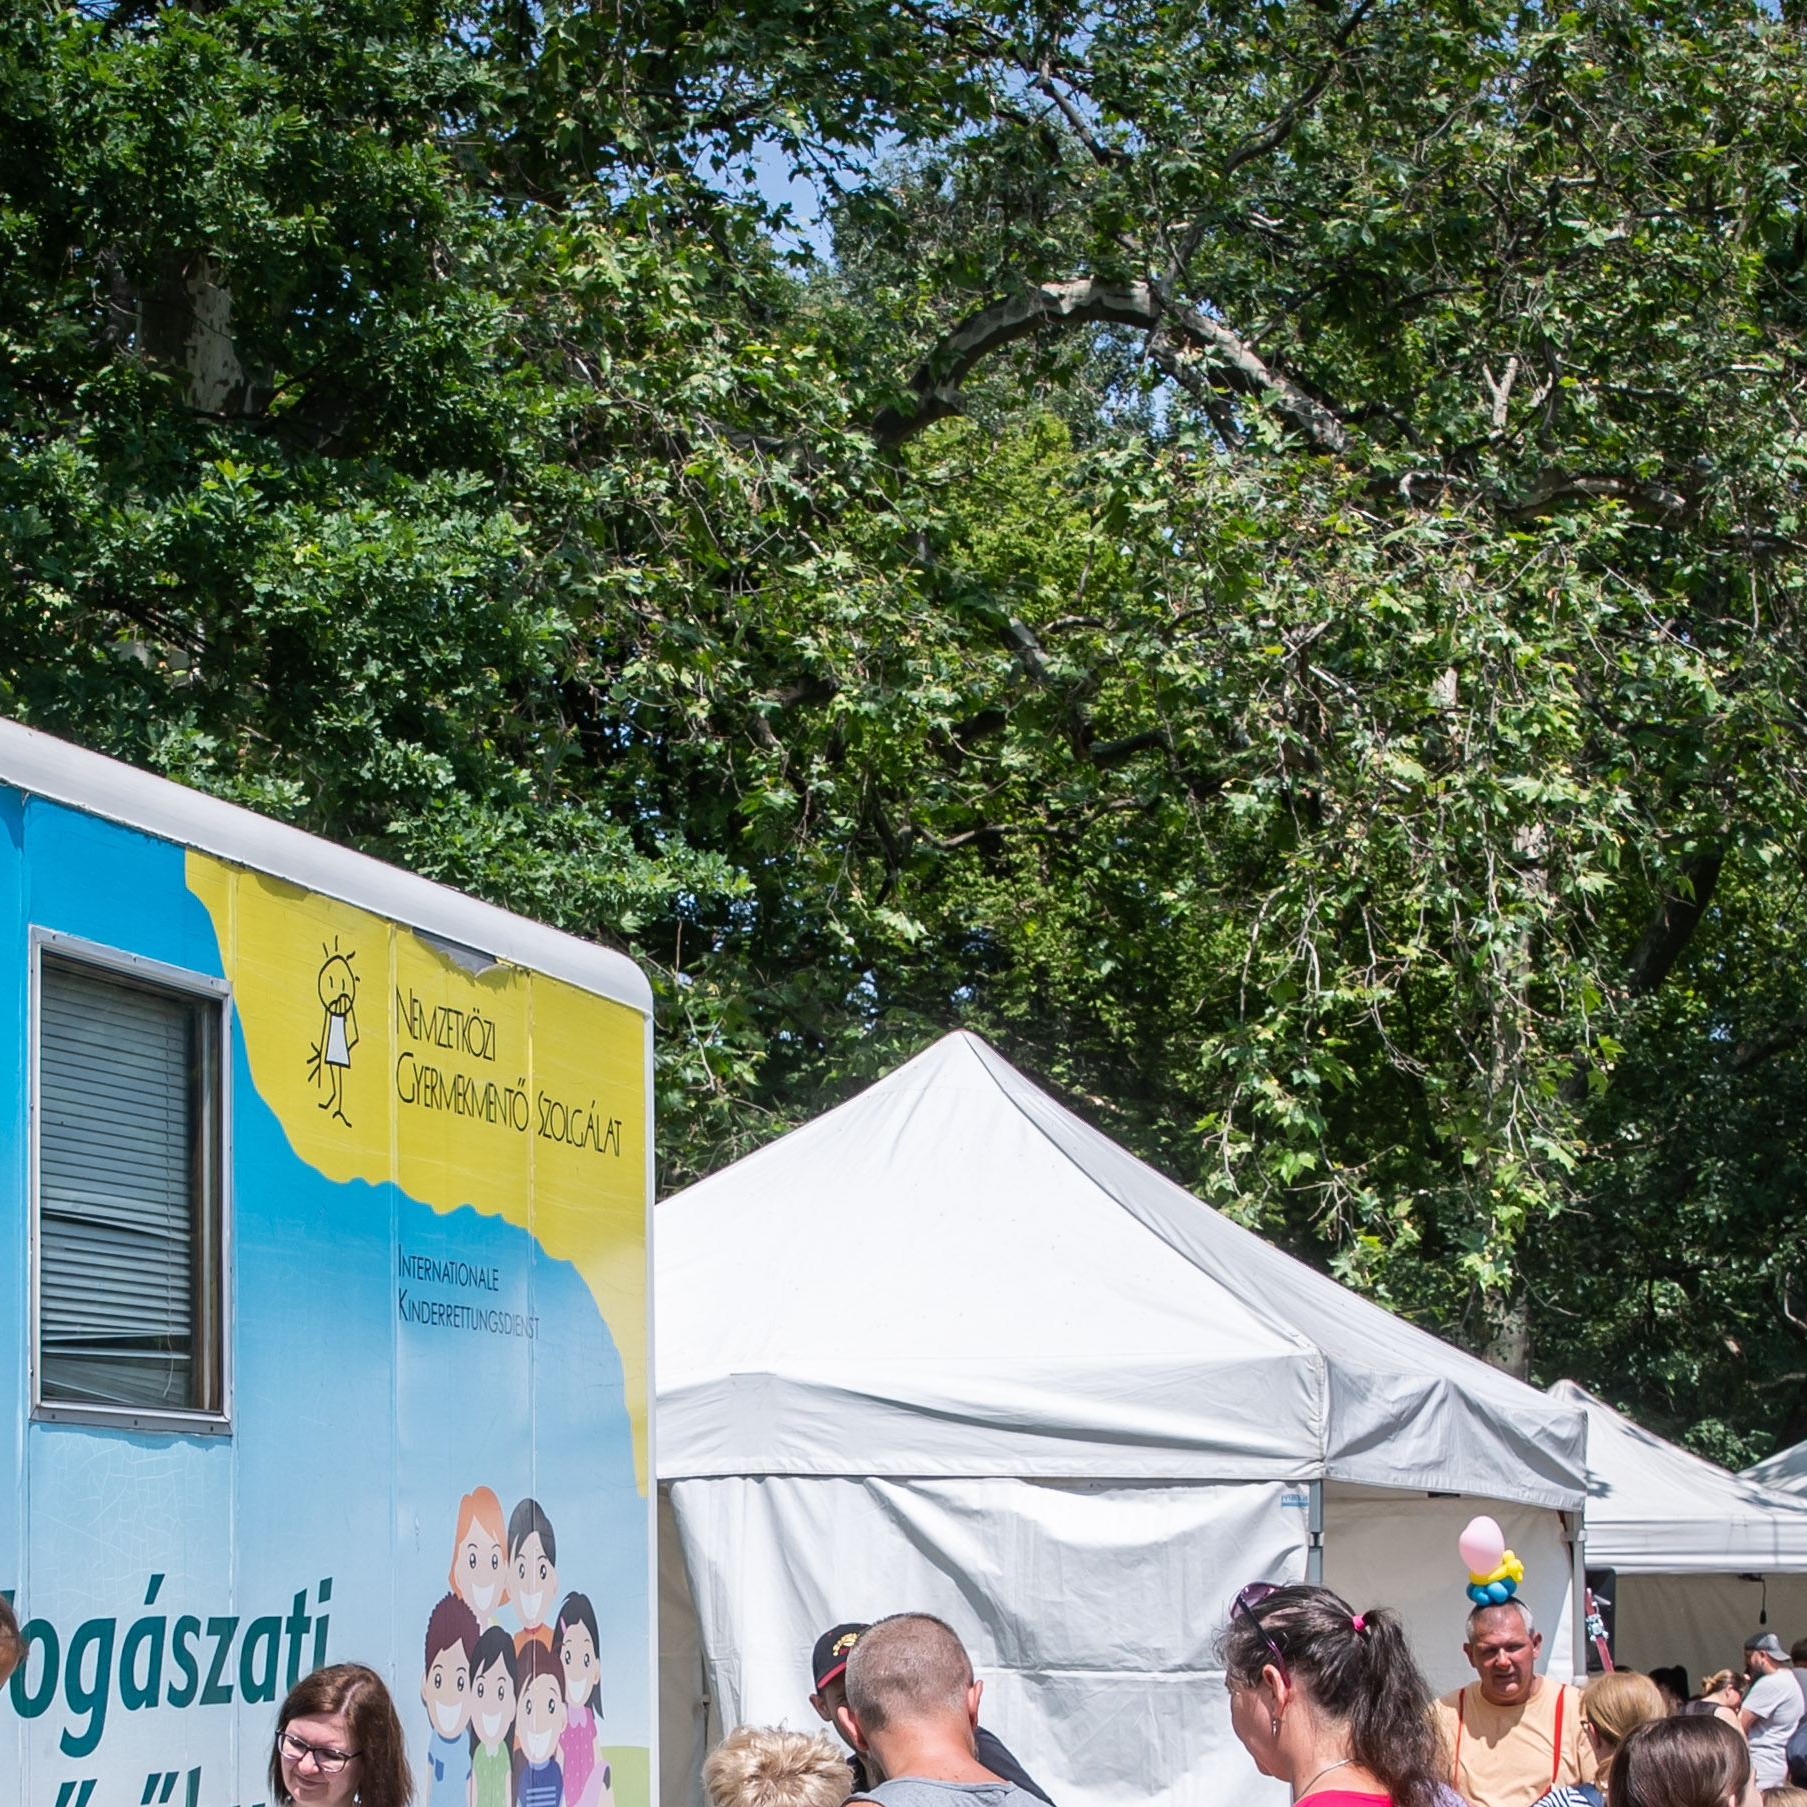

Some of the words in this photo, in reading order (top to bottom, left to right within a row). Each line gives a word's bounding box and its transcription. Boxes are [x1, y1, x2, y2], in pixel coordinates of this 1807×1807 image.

[396, 985, 496, 1061] NEMZETKÖZI
[396, 1051, 529, 1132] GYERMEKMENTŐ
[538, 1090, 622, 1157] SZOLGÁLAT
[398, 1244, 499, 1291] INTERNATIONALE
[398, 1288, 540, 1340] KINDERRETTUNGSDIENST
